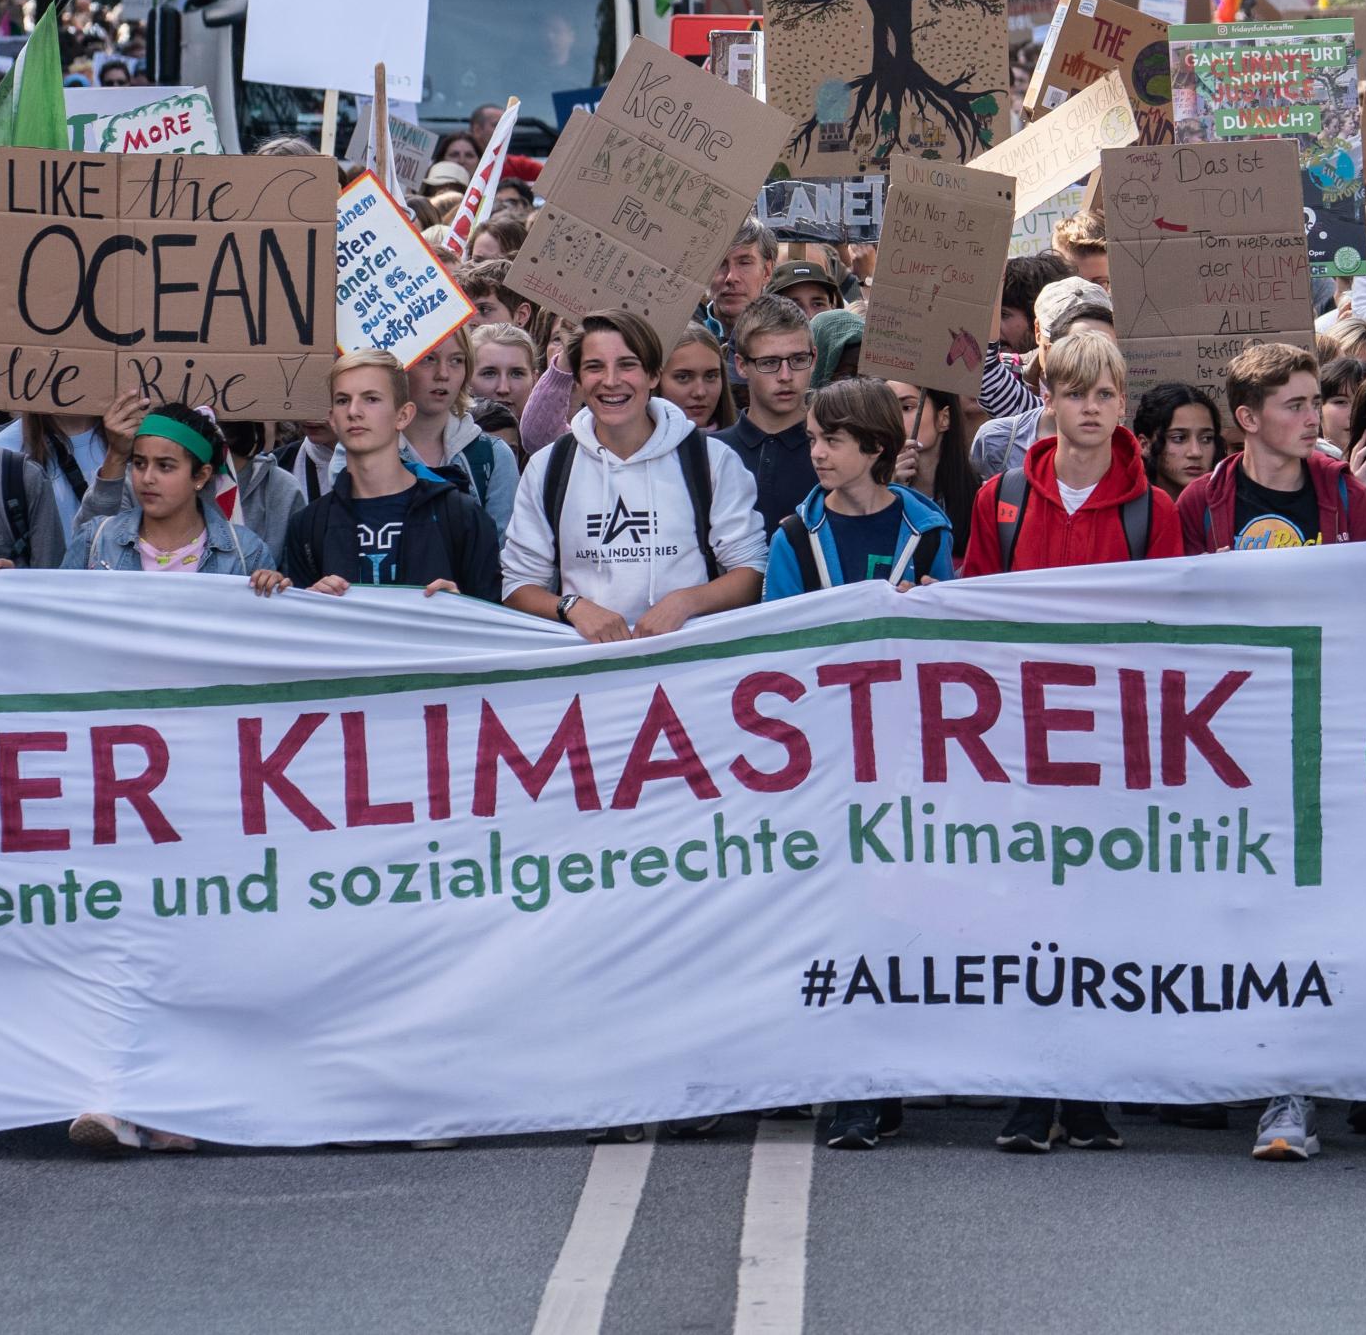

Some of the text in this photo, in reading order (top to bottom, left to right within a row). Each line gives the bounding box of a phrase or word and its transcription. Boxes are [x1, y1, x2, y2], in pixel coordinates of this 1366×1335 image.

[1093, 16, 1132, 63] THE
[1185, 45, 1344, 68] GANZ FRANKFURT
[622, 61, 733, 162] Keine
[1049, 122, 1064, 145] IS
[1066, 76, 1126, 132] CHANGING
[1210, 78, 1316, 104] JUSTICE
[123, 111, 192, 154] MORE
[1222, 114, 1247, 130] DU
[1064, 131, 1086, 163] WE
[1172, 148, 1230, 183] Das
[1236, 149, 1265, 176] ist
[8, 156, 239, 223] LIKE the
[591, 126, 731, 229] KOHLE
[905, 164, 969, 192] UNICORNS
[611, 194, 663, 242] Für
[755, 174, 886, 229] LANET
[895, 191, 976, 233] MAY NOT BE
[1186, 185, 1265, 219] TOM
[538, 212, 661, 306] KOHLE
[892, 220, 985, 258] REAL BUT THE
[1192, 229, 1232, 250] Tom
[1308, 249, 1326, 257] Oper
[18, 224, 316, 346] OCEAN
[890, 248, 975, 285] CLIMATE CRISIS
[1198, 254, 1308, 280] der KLIMA
[353, 264, 408, 319] gibt es
[361, 264, 439, 335] auch keine
[1204, 281, 1308, 304] WANDEL
[1218, 310, 1275, 333] ALLE
[128, 355, 259, 413] Rise
[1196, 363, 1214, 380] ist
[237, 658, 1253, 837] KLIMASTREIK
[153, 847, 278, 919] und
[307, 811, 820, 913] sozialgerechte
[848, 794, 1278, 888] Klimapolitik
[802, 941, 1333, 1015] #ALLEFÜRSKLIMA
